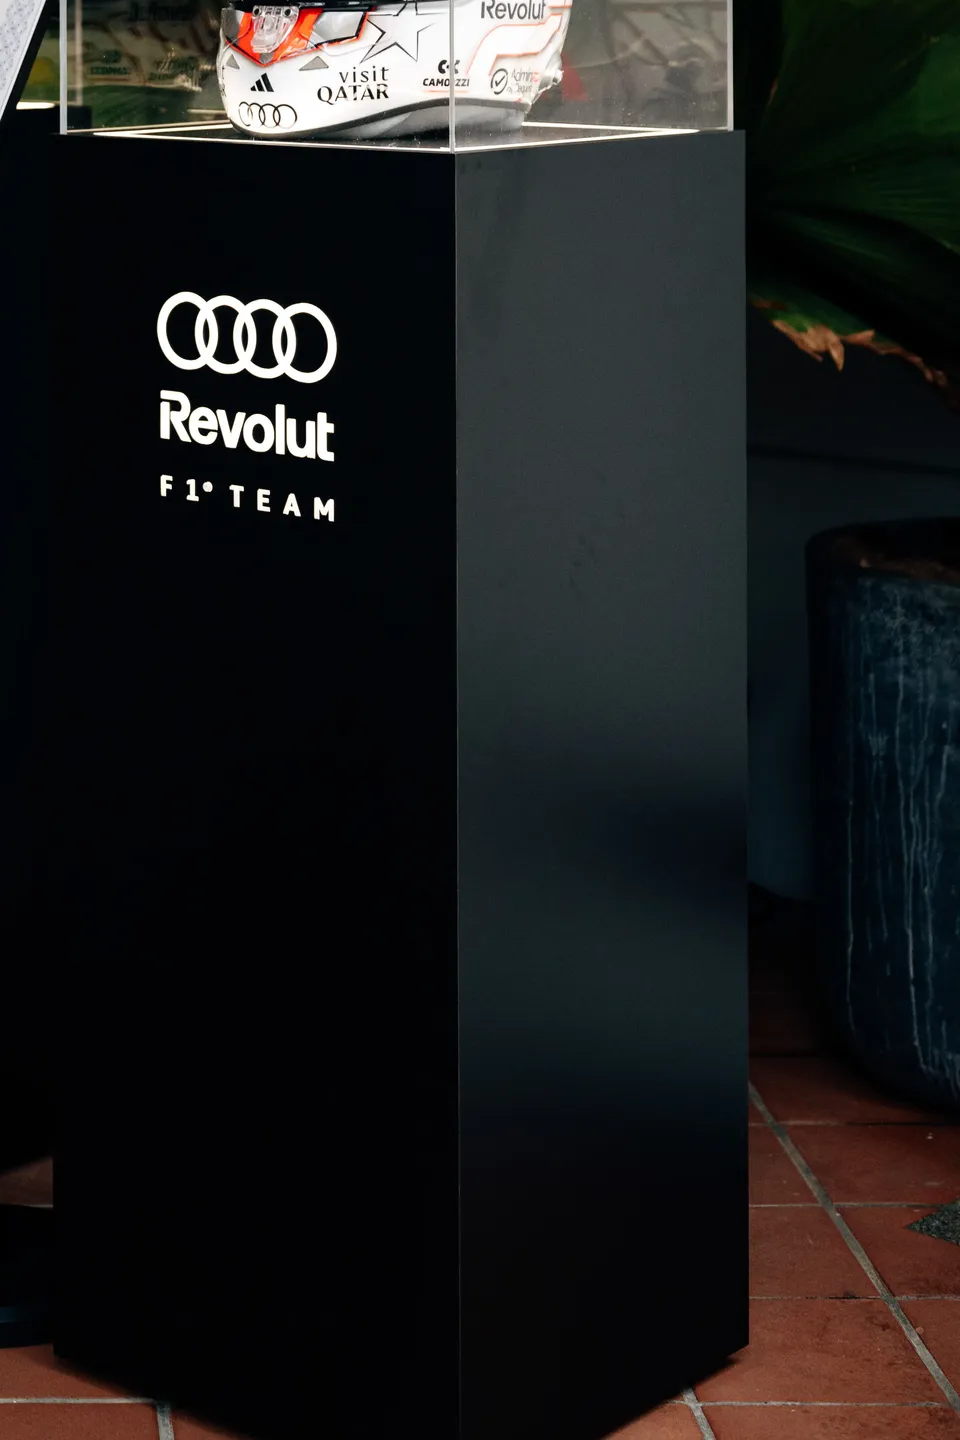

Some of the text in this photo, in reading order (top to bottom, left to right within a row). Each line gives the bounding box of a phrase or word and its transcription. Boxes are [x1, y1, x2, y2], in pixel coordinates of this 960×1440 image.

[339, 65, 390, 84] visit
[316, 83, 390, 106] QATAR
[159, 389, 335, 462] Revolut
[229, 483, 335, 522] TEAM
